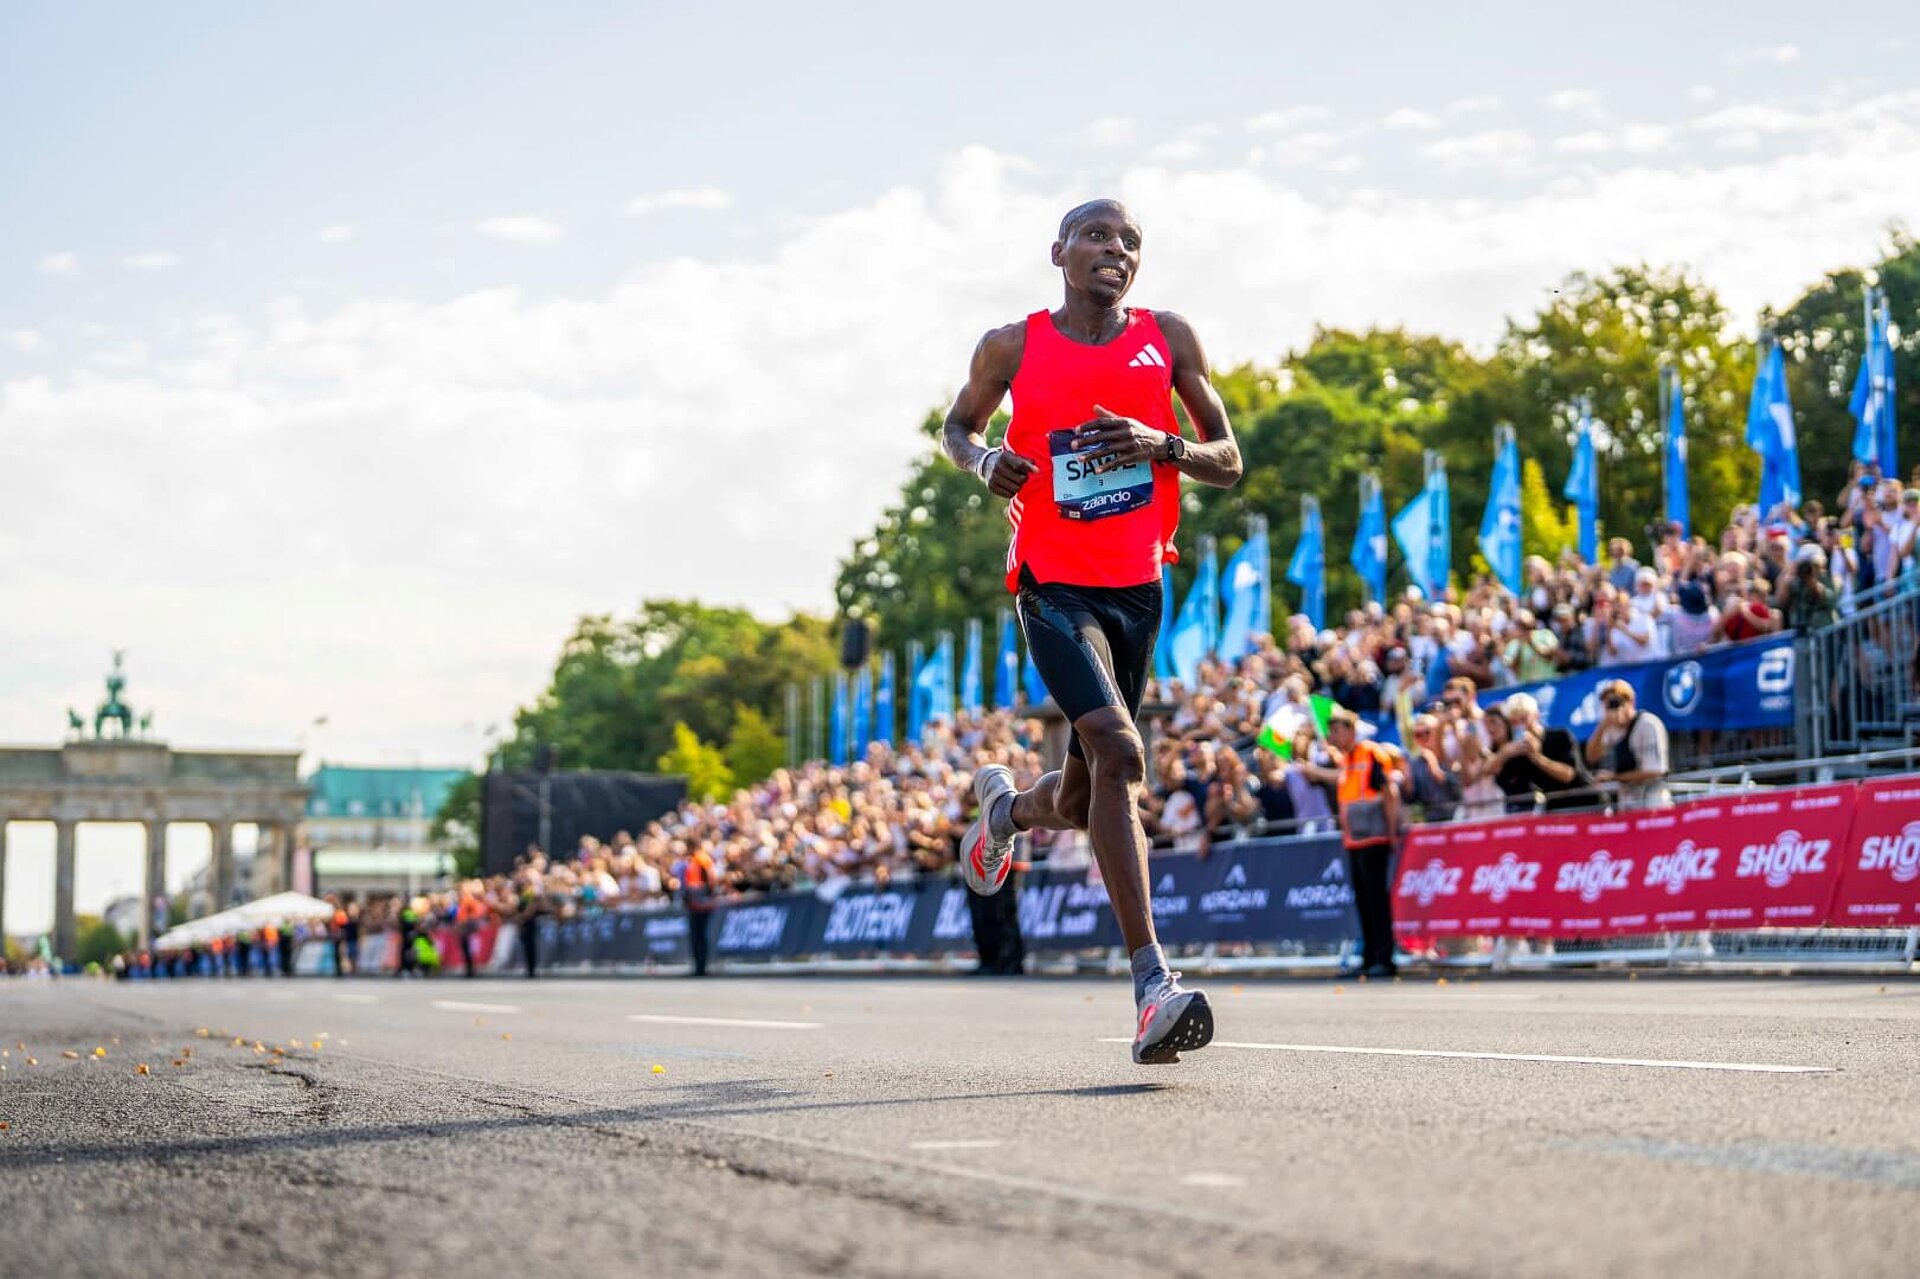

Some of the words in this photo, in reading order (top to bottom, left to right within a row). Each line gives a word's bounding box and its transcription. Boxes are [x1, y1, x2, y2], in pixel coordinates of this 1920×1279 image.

[1081, 490, 1131, 511] zalando
[1470, 855, 1542, 899] SHOKZ
[1555, 853, 1634, 899] SHOKZ
[1644, 842, 1720, 892] SHOKZ
[1735, 833, 1831, 883] SHOKZ
[1398, 861, 1463, 902] SHOKZ
